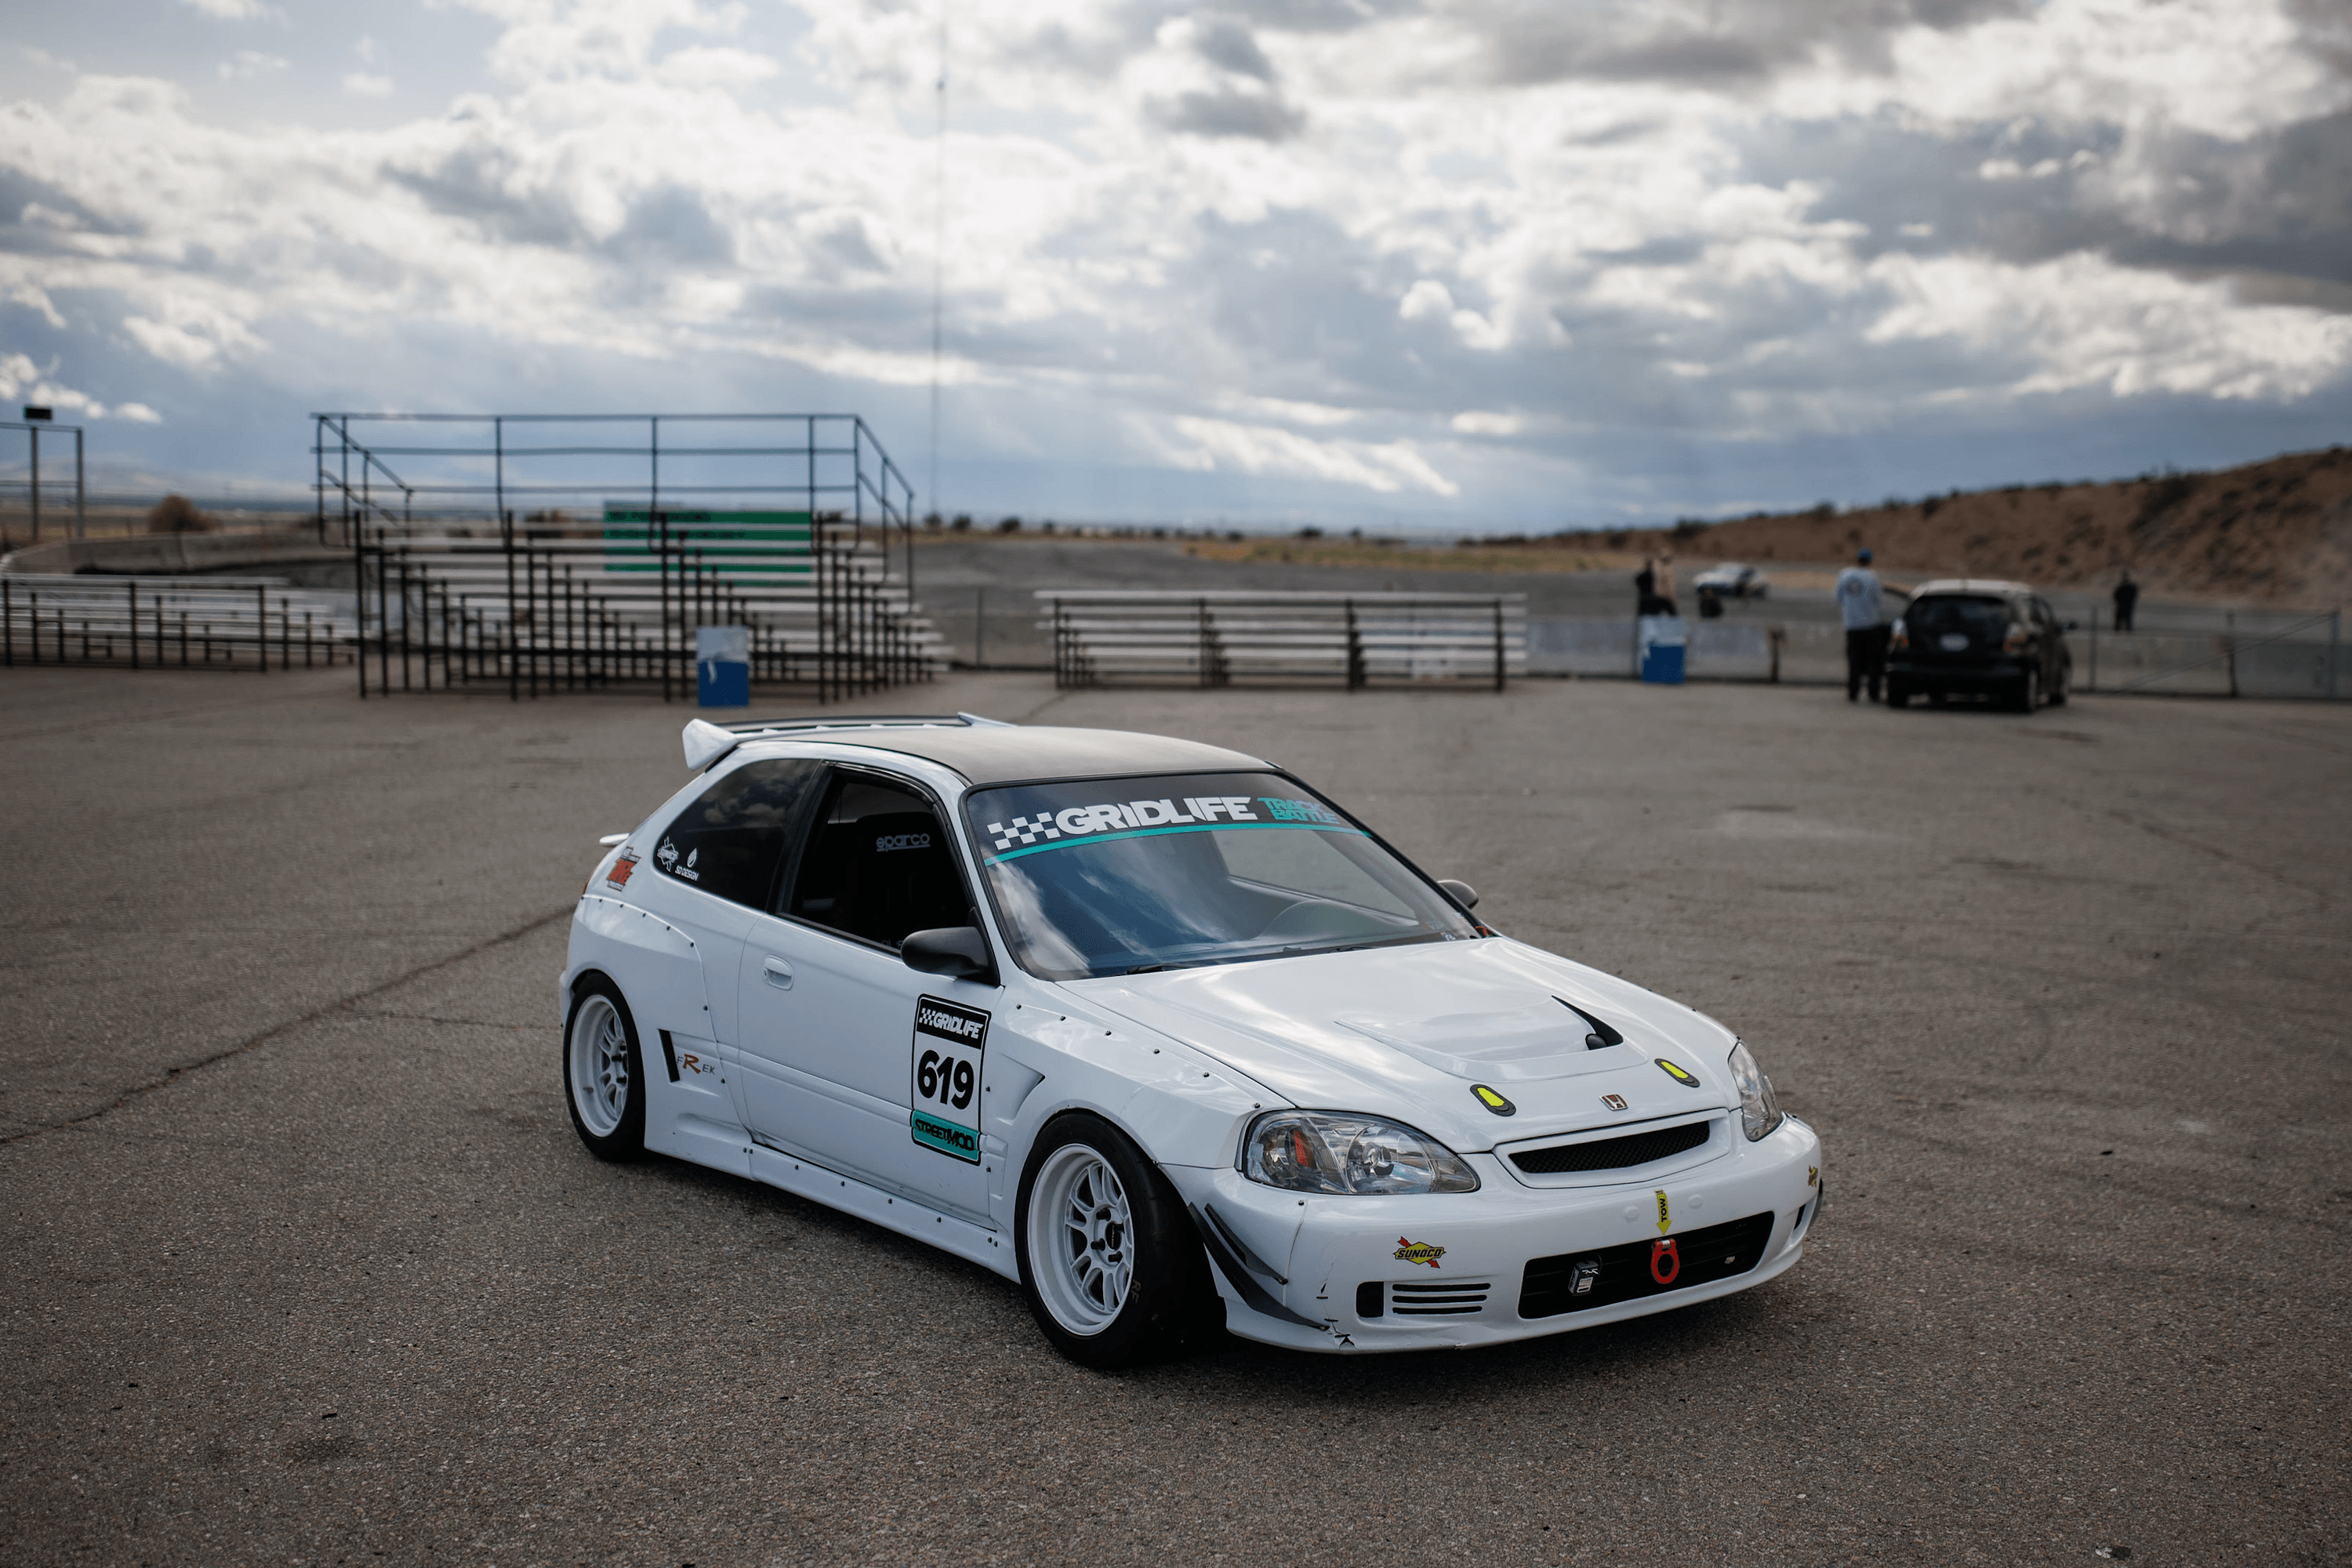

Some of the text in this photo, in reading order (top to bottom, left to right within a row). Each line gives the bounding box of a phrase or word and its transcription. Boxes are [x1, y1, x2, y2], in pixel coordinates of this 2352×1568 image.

[1055, 797, 1258, 835] GRIDLIFE
[933, 1012, 984, 1040] GRIDLIFE
[916, 1049, 975, 1110] 619
[1659, 1198, 1668, 1222] TOW
[1397, 1248, 1443, 1258] SUNOCO
